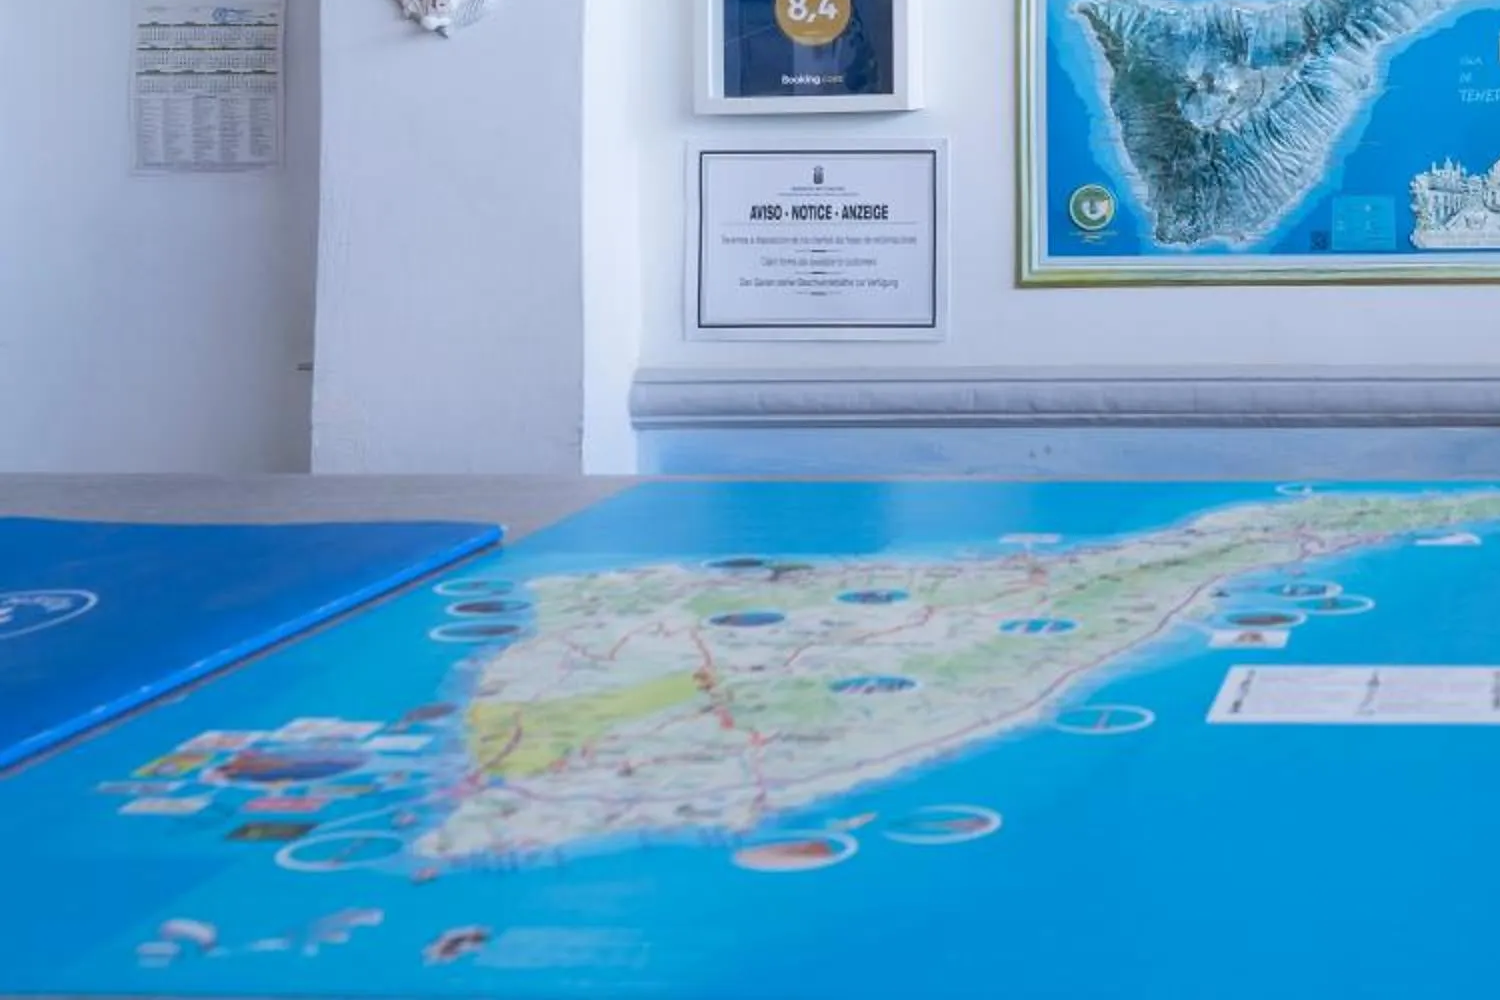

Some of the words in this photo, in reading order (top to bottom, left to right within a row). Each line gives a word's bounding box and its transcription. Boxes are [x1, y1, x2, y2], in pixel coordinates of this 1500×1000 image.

[750, 205, 782, 221] AVISO
[791, 205, 832, 220] NOTICE
[841, 204, 889, 220] ANZEIGE
